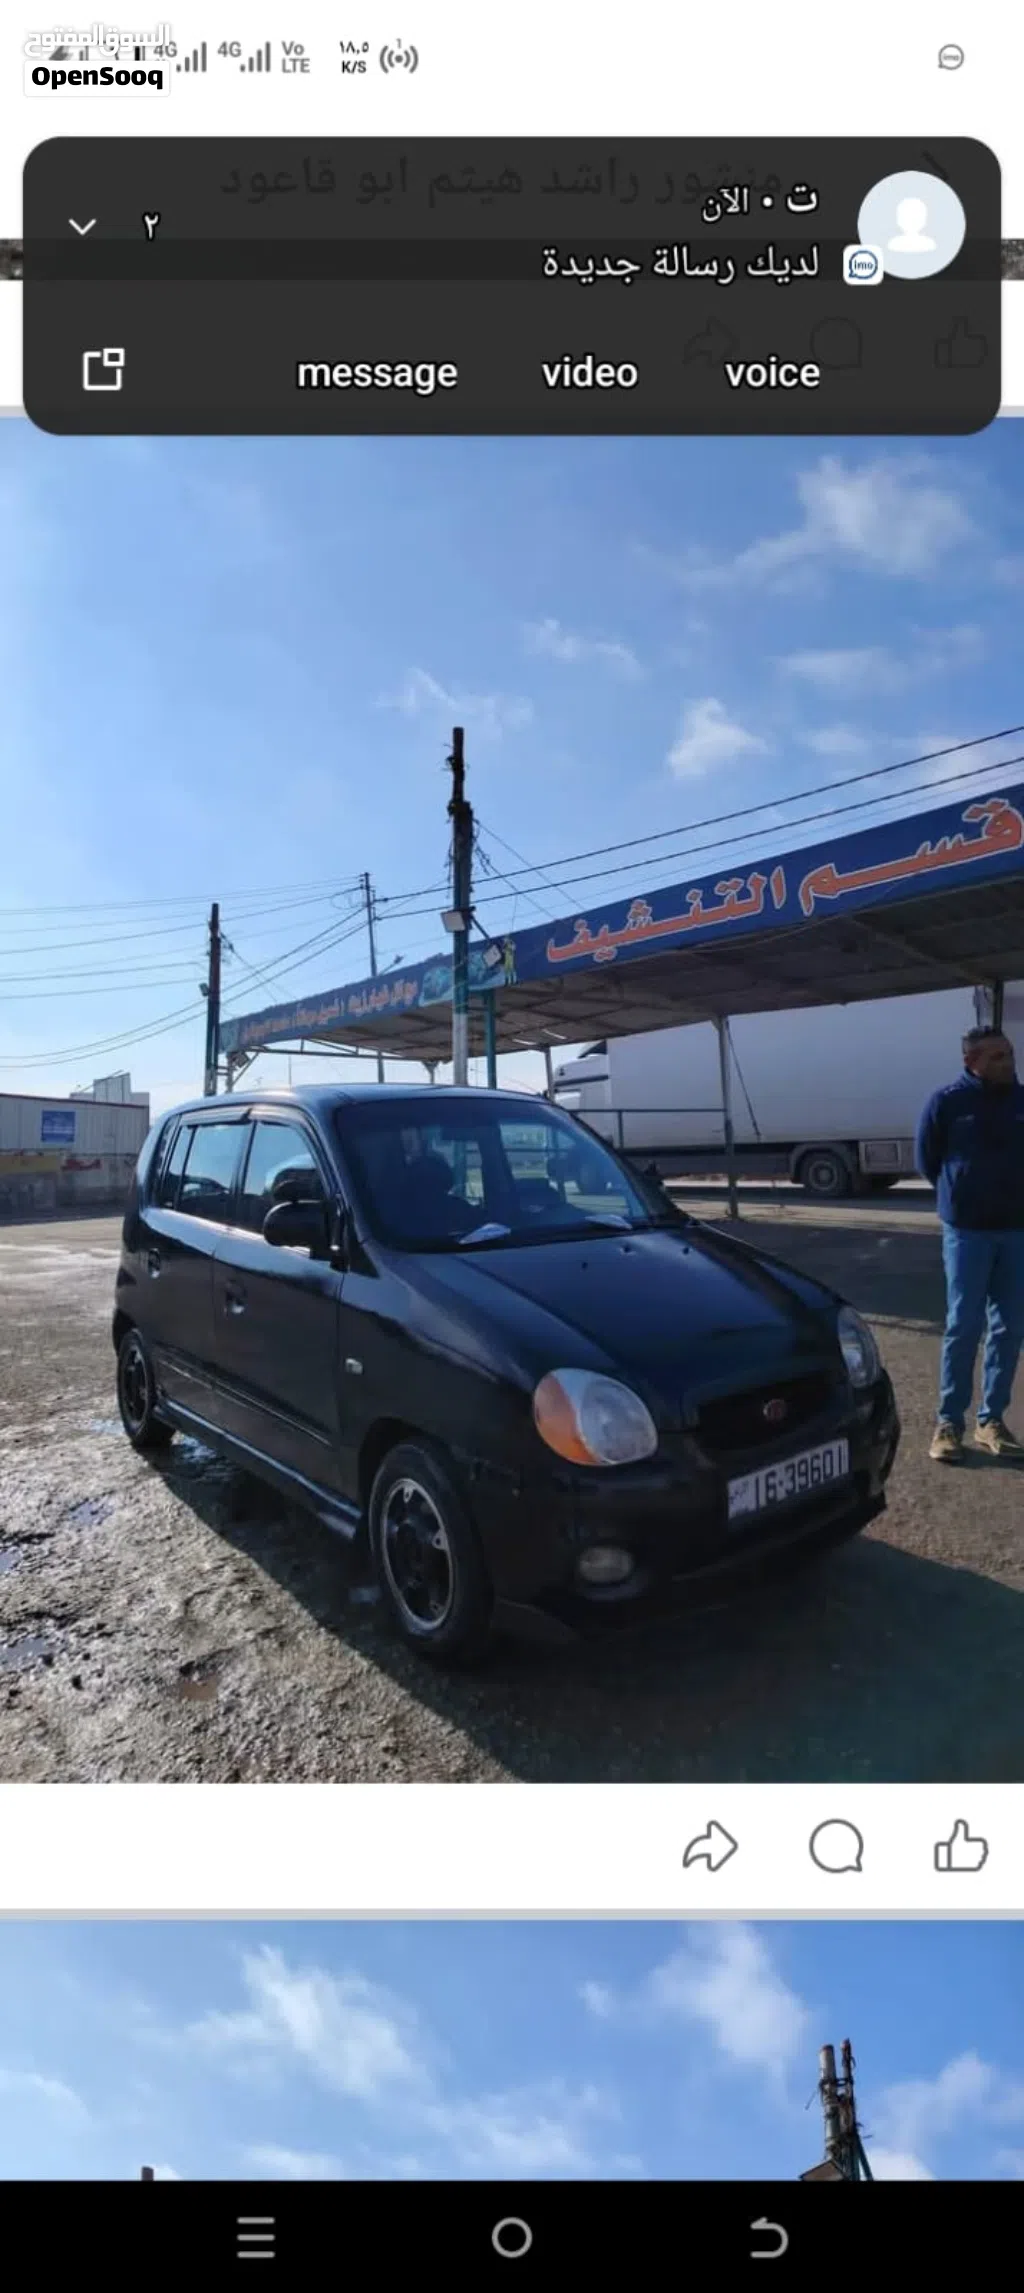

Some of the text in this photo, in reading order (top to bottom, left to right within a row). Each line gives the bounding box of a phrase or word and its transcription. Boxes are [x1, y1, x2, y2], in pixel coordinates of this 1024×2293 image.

[153, 41, 178, 58] 4G
[217, 41, 242, 58] 4G
[281, 41, 305, 56] Vo
[282, 58, 310, 73] LTE
[341, 60, 367, 74] K/S
[220, 156, 336, 205] قاعود
[356, 156, 408, 204] ابو
[540, 156, 639, 205] راشد
[703, 186, 817, 222] ت الآن
[144, 215, 159, 238] ٢
[543, 246, 818, 284] لديك رسالة جديدة
[854, 259, 873, 270] imo
[298, 363, 458, 395] message
[542, 355, 638, 387] video
[725, 356, 820, 387] voice
[547, 798, 1024, 962] قسم التنشيف
